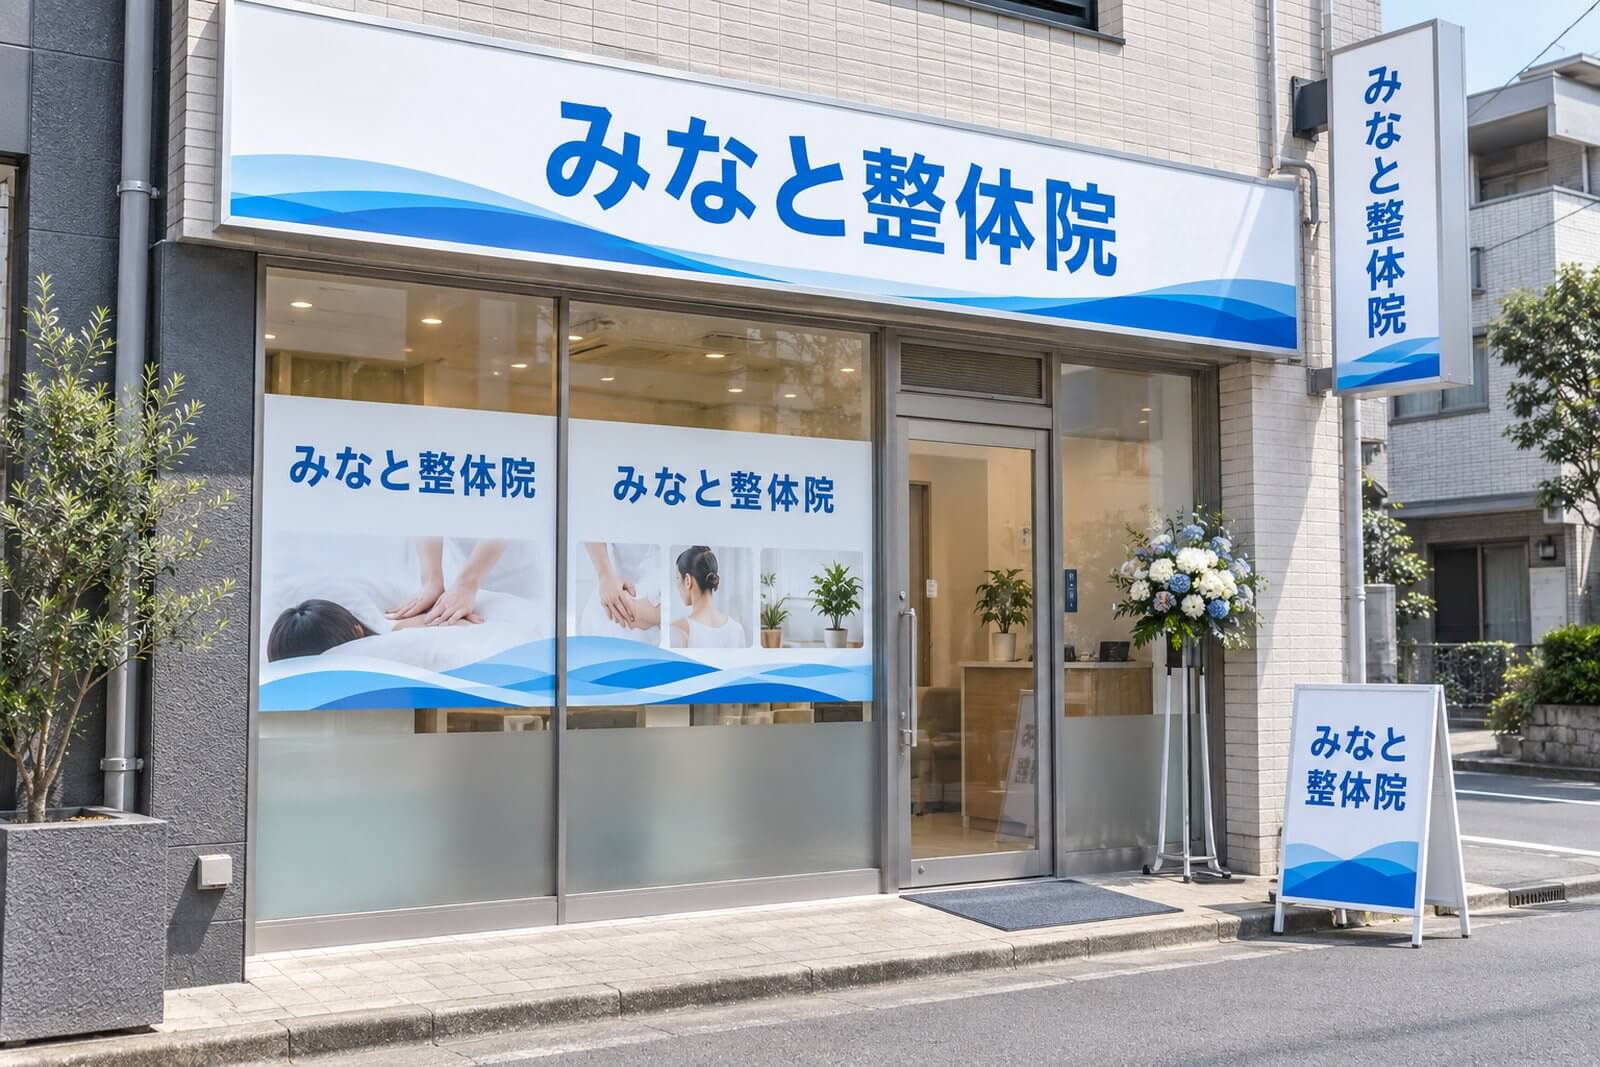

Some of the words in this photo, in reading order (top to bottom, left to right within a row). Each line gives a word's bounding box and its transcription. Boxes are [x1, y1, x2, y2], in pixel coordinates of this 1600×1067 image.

[545, 100, 1118, 277] みなと整体院
[1363, 65, 1406, 338] みなと整体院
[289, 445, 536, 499] みなと整体院
[613, 465, 835, 514] みなと整体院
[1310, 725, 1406, 762] みなと
[1304, 768, 1408, 812] 整体院
